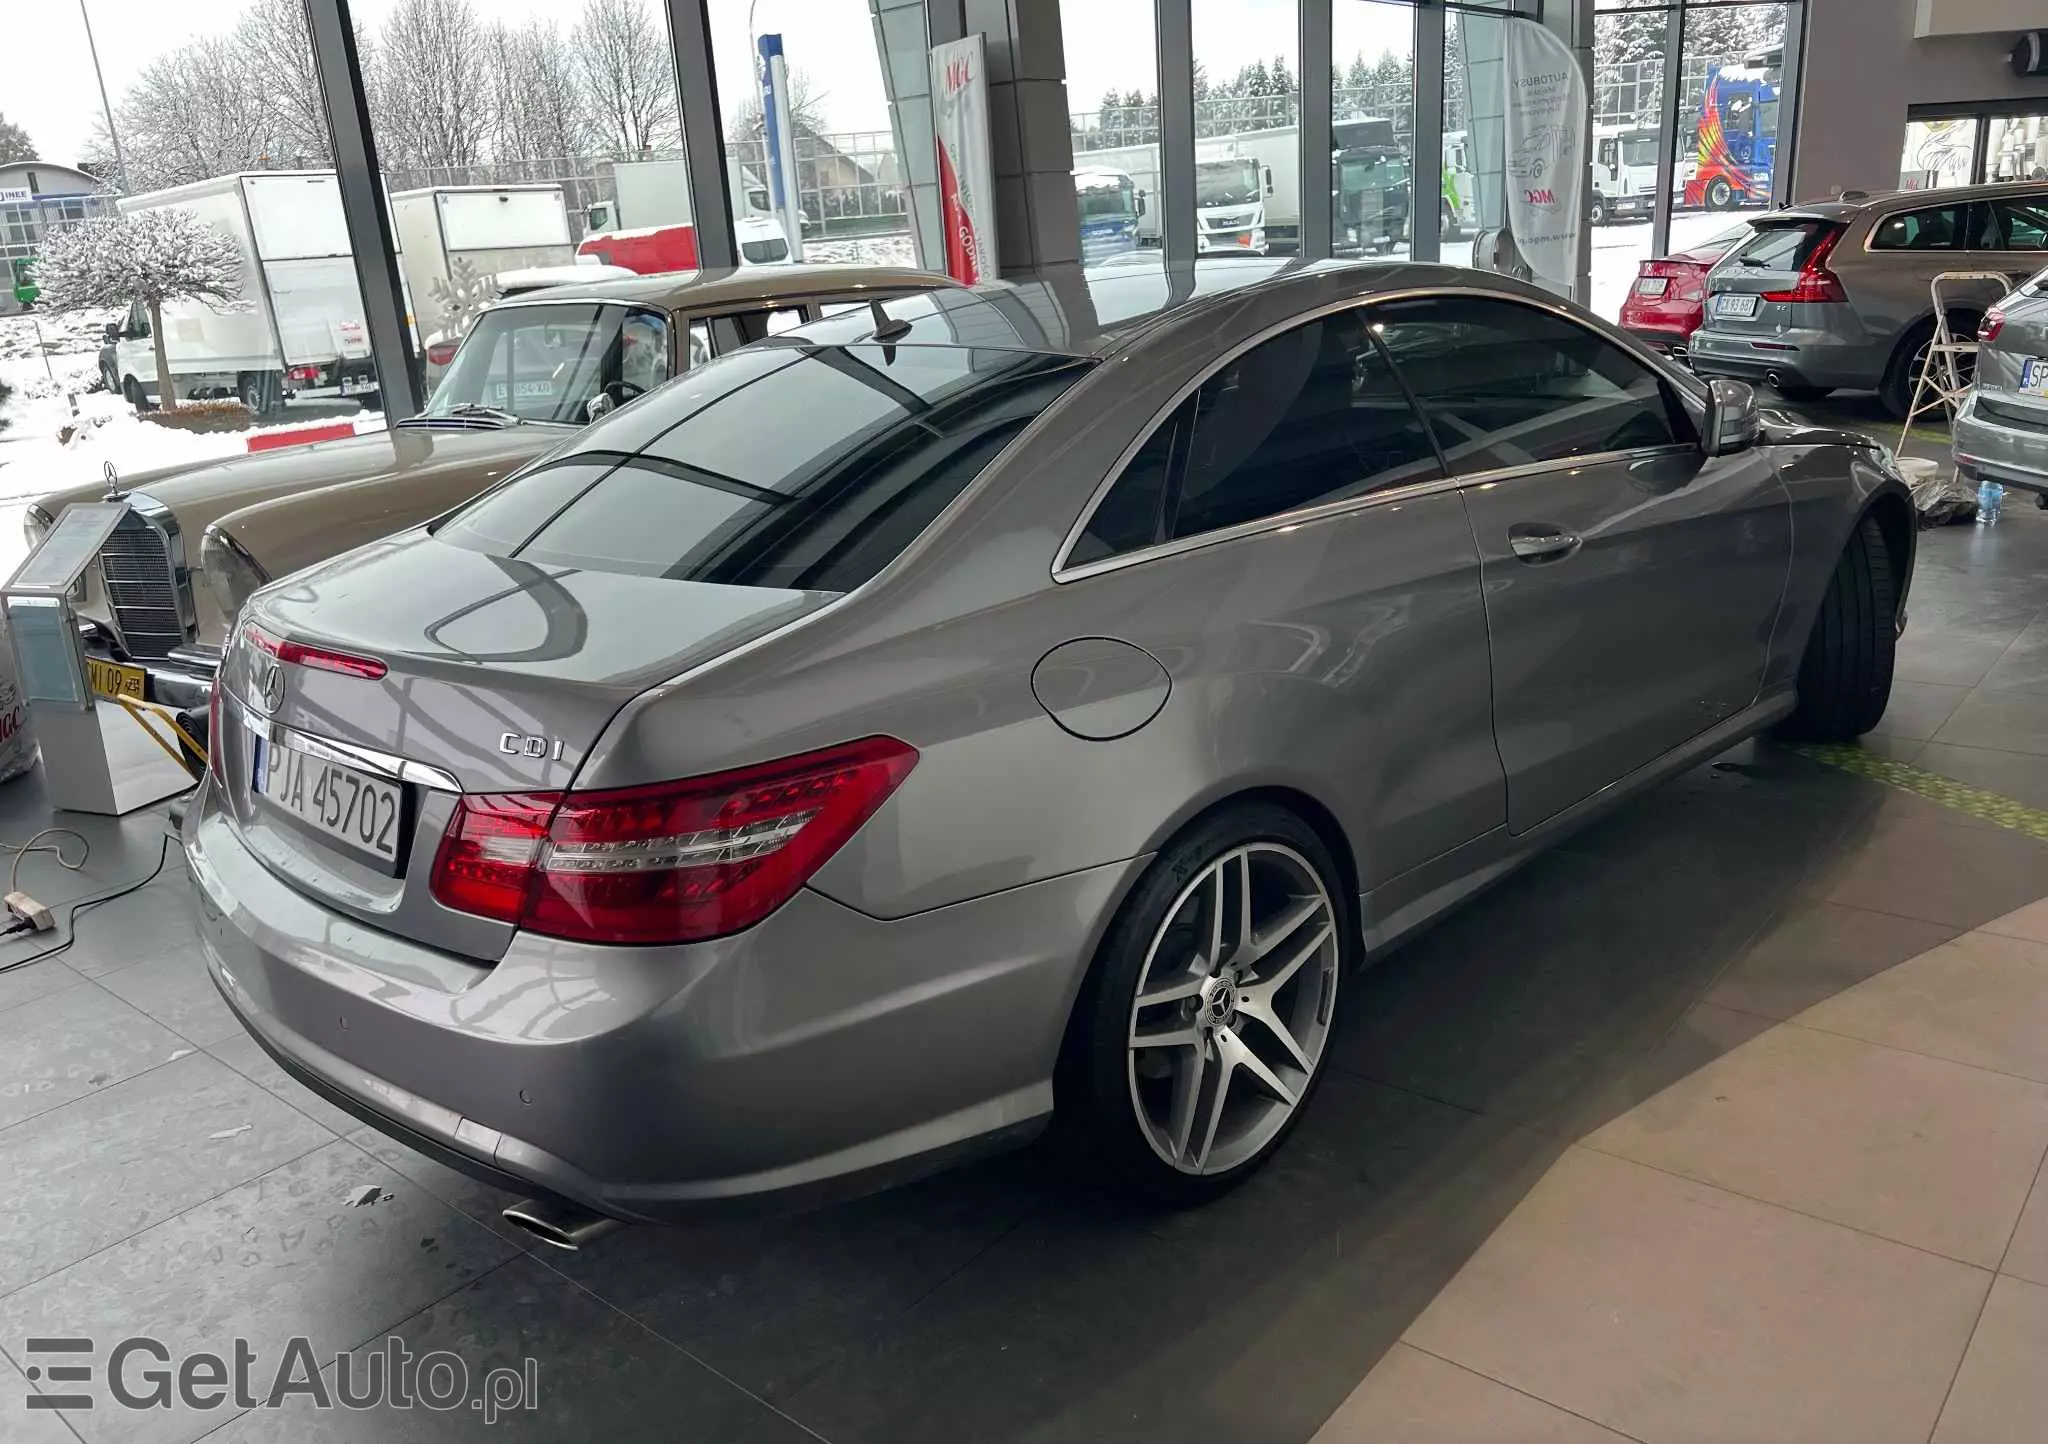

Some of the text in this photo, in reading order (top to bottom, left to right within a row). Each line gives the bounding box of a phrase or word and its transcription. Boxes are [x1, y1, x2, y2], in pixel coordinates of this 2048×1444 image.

[500, 732, 564, 761] CDI
[266, 744, 396, 854] PJA 45702
